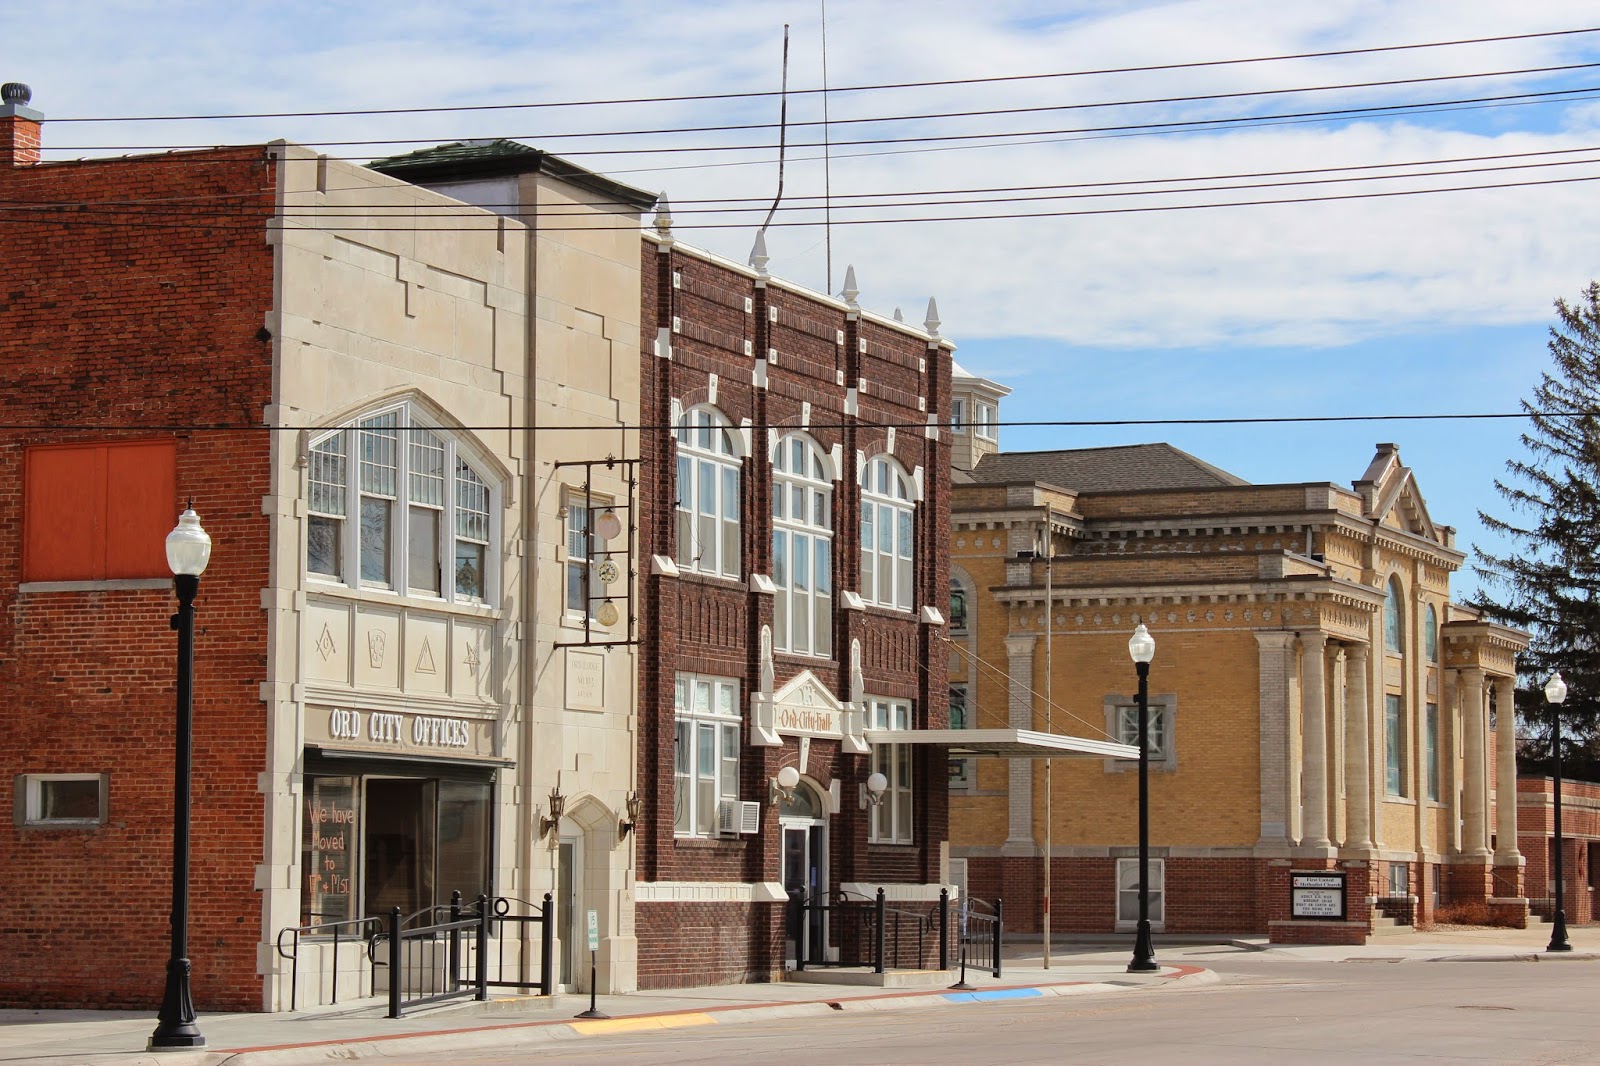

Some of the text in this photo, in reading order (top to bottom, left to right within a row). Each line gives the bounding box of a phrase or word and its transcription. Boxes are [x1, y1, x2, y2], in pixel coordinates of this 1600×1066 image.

[330, 708, 470, 746] ORD CITY OFFICES
[781, 708, 797, 729] Ord
[799, 710, 815, 732] City
[308, 799, 354, 824] We have
[311, 830, 345, 850] Moved
[324, 854, 336, 870] to
